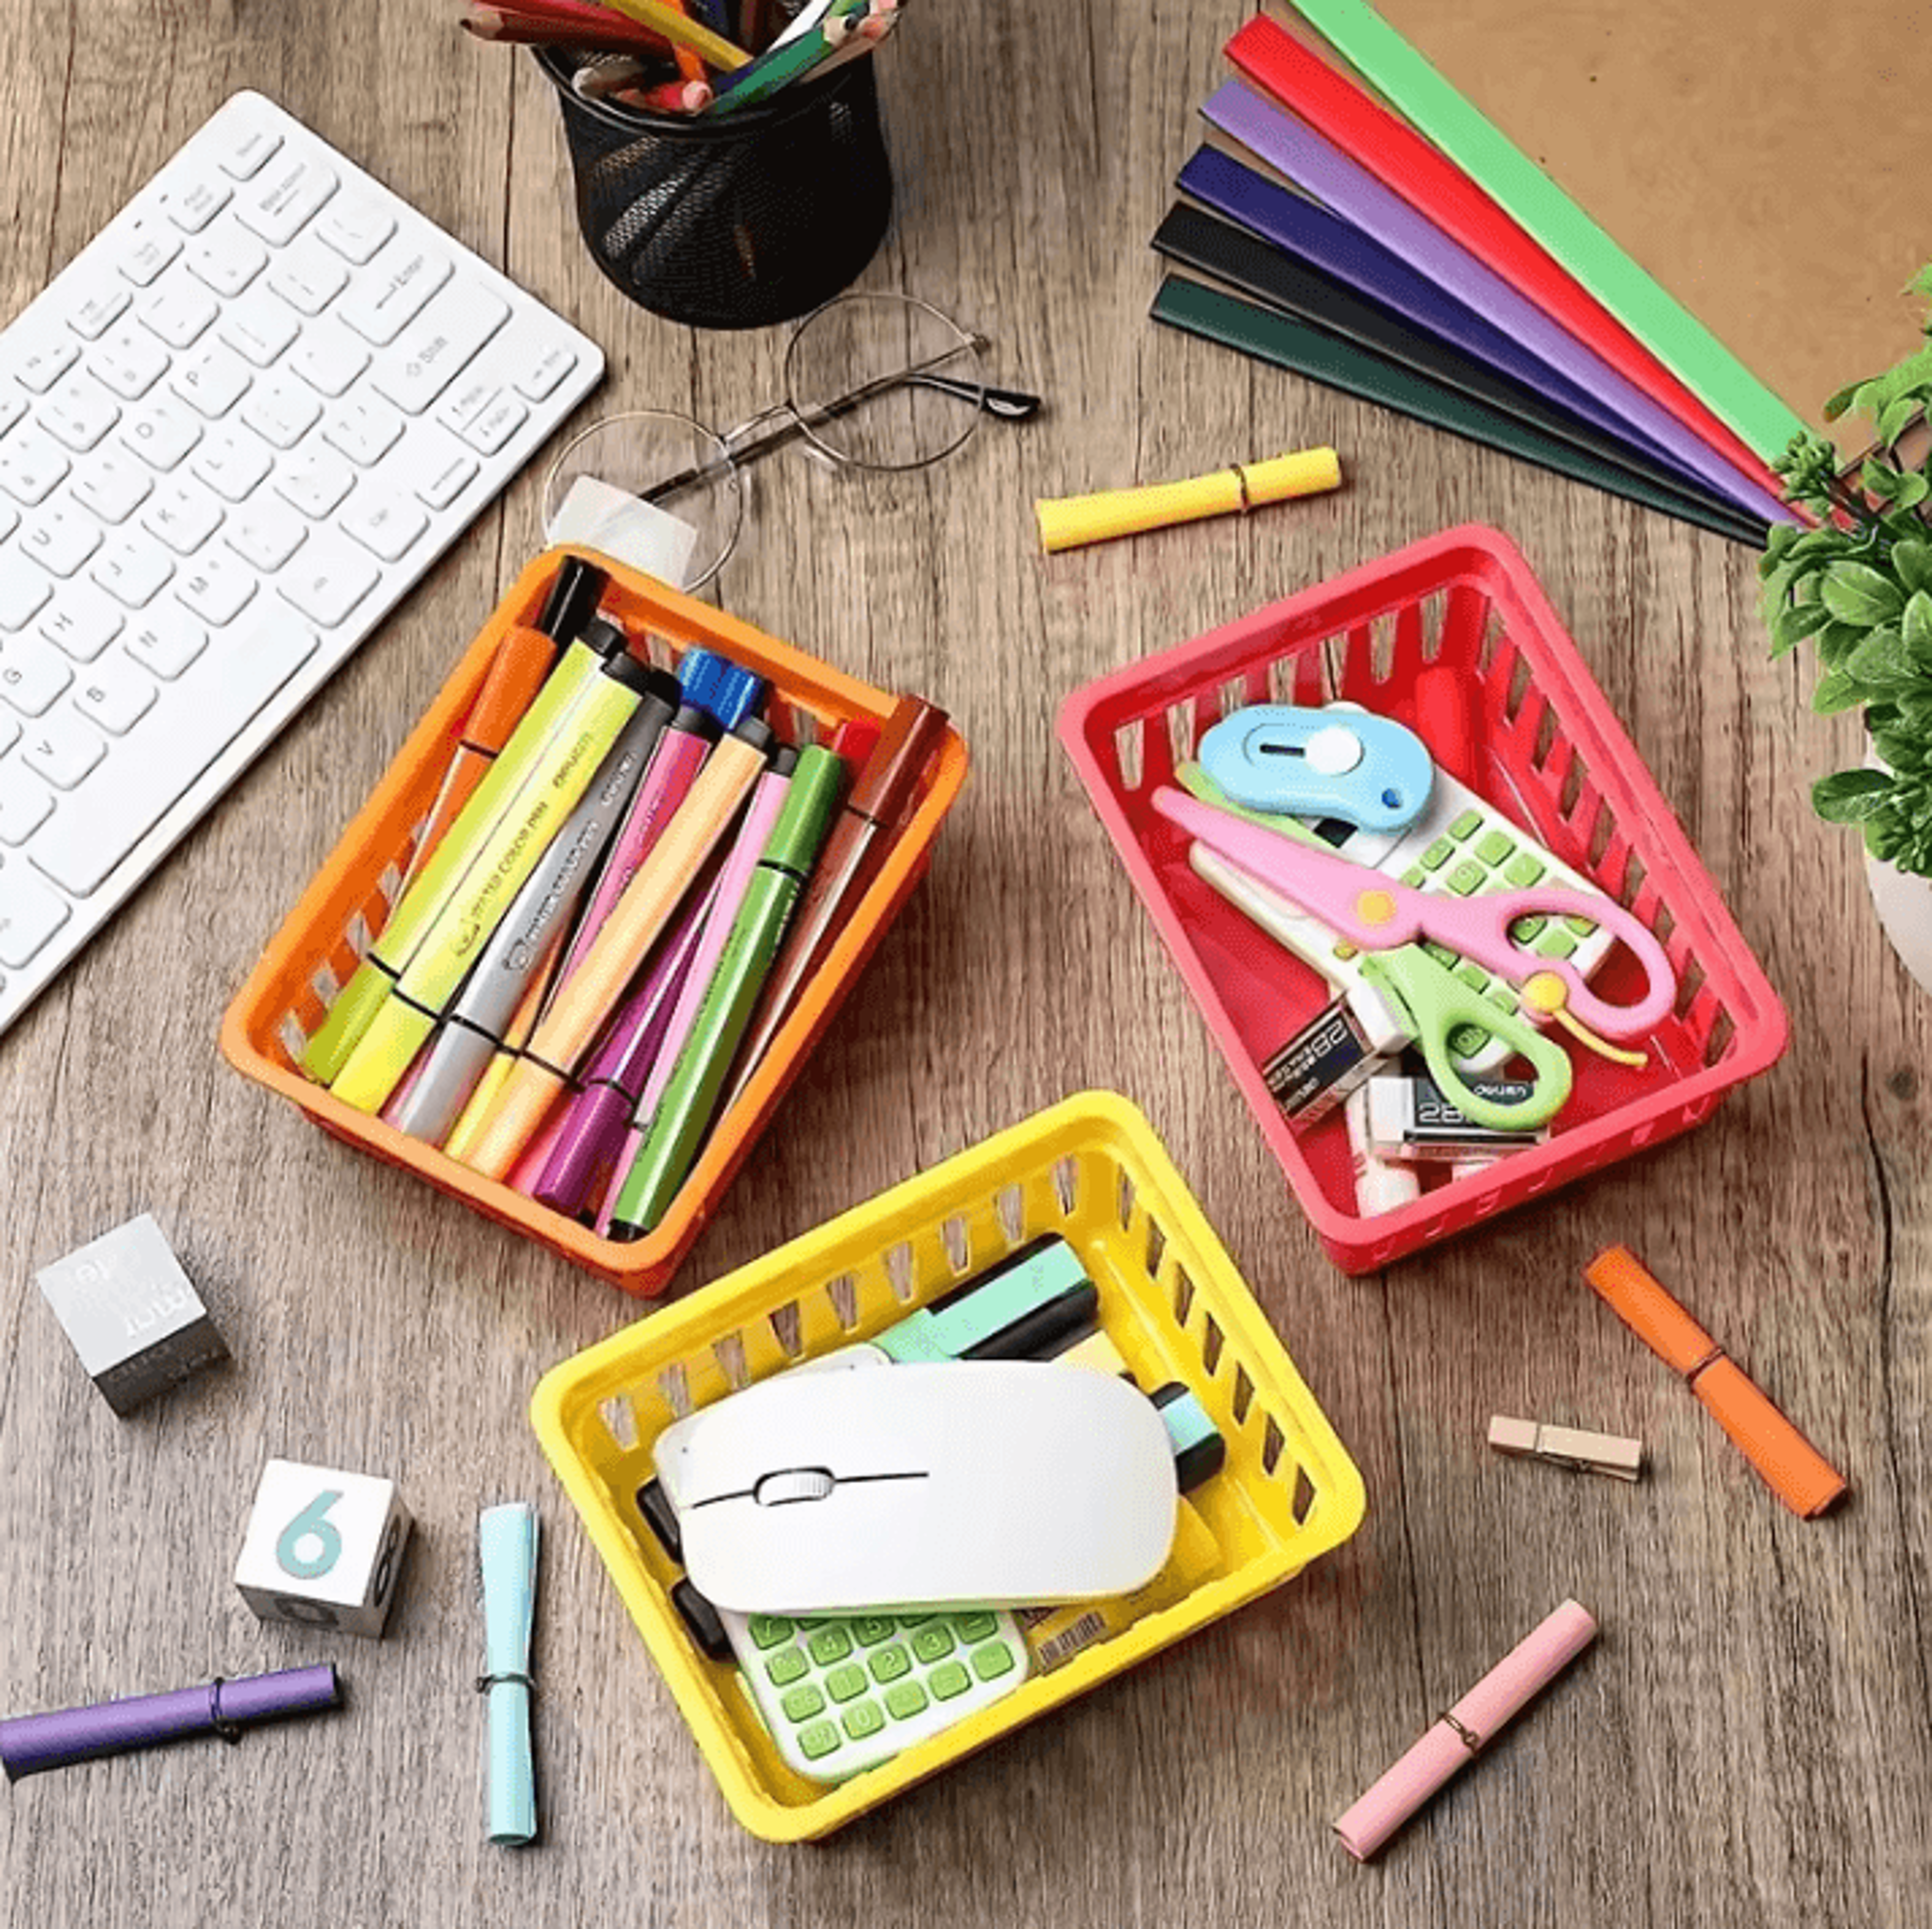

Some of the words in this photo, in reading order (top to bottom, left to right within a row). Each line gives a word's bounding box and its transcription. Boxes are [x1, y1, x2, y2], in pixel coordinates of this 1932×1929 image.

[53, 612, 73, 631] H
[3, 667, 22, 685] G
[276, 1488, 344, 1580] 6
